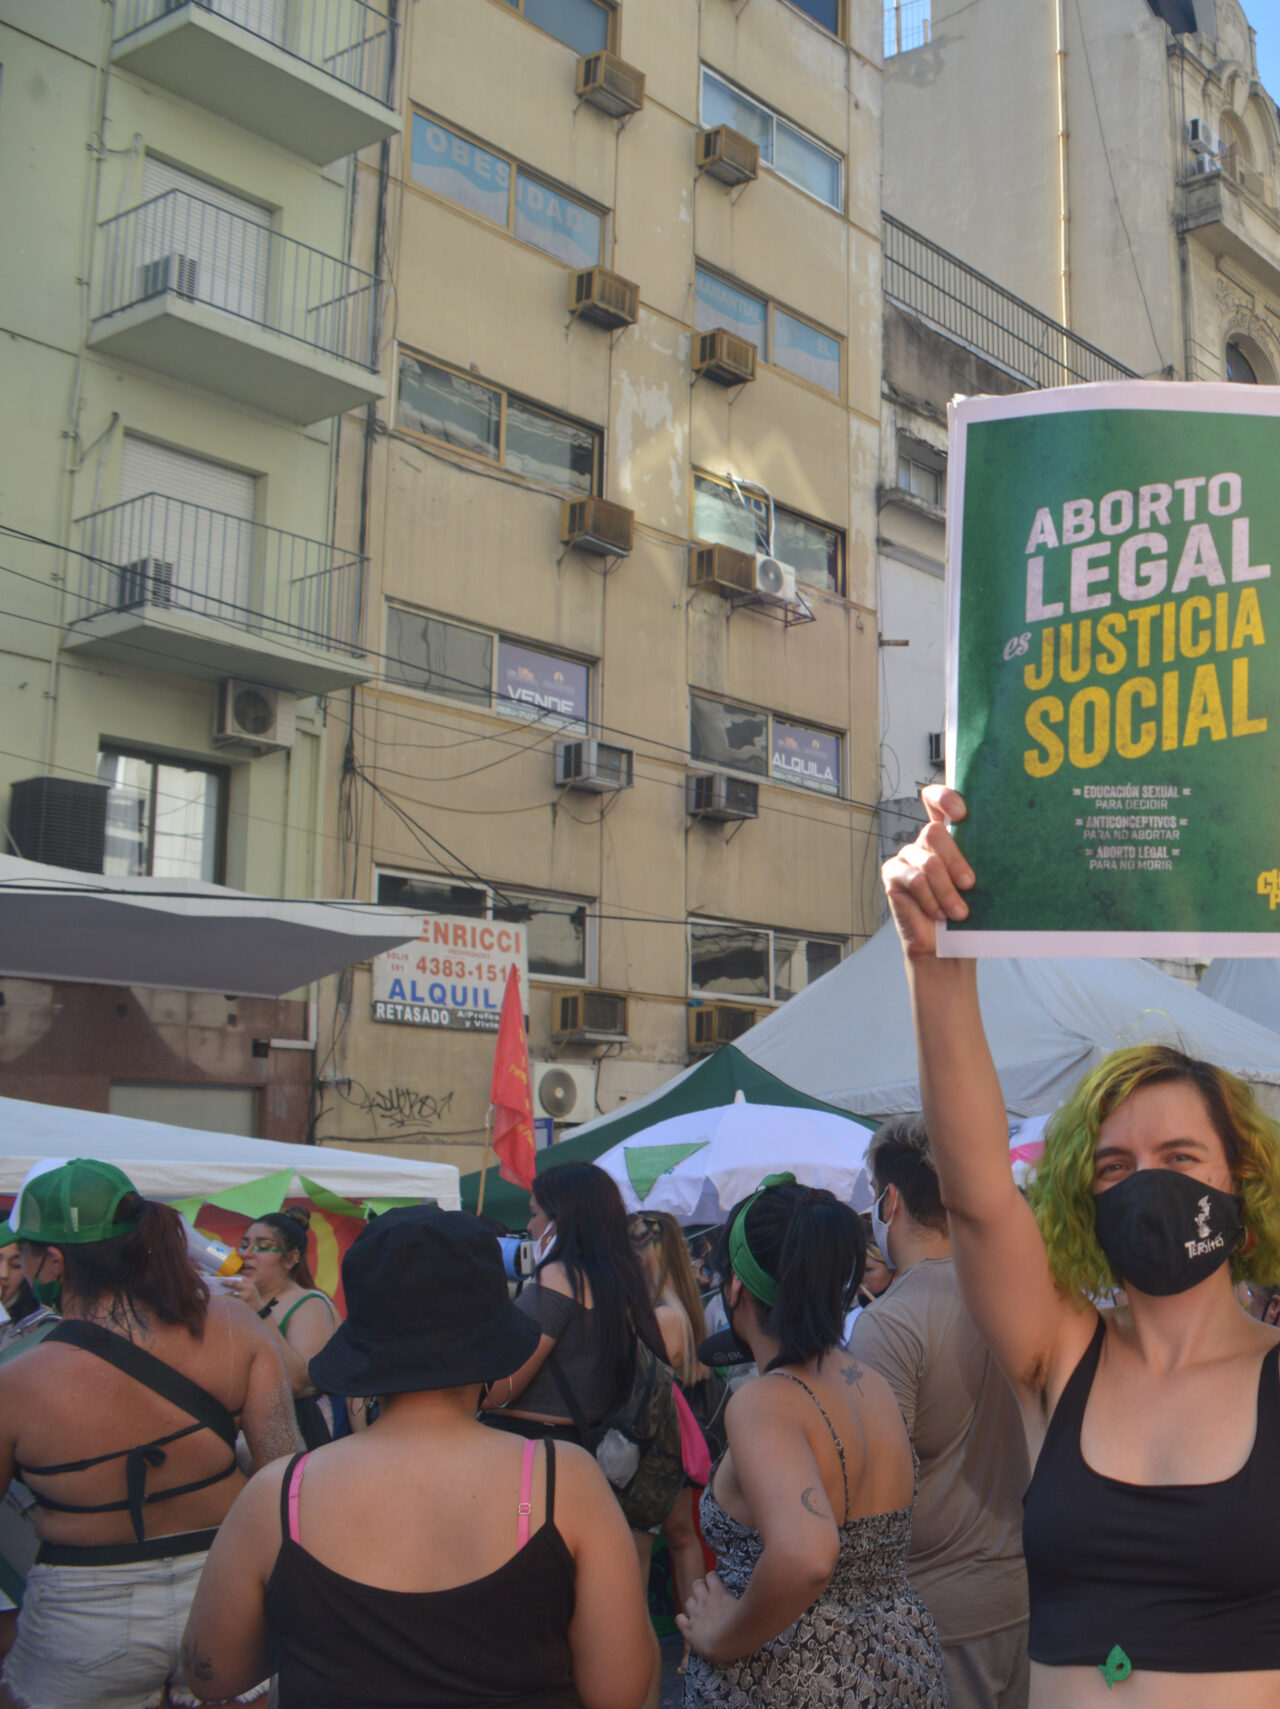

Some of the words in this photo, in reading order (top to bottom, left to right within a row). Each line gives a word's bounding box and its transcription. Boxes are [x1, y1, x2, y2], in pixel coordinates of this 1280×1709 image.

[425, 126, 583, 231] OBESIDAD
[1025, 472, 1242, 554] ABORTO
[1025, 517, 1271, 623] LEGAL
[1003, 632, 1032, 661] es
[1024, 587, 1266, 691] JUSTICIA
[507, 685, 575, 713] VENDE
[1023, 656, 1268, 778] SOCIAL
[772, 752, 833, 781] ALQUILA
[1083, 782, 1139, 799] EDUCACIÓN
[1142, 785, 1180, 798] SEXUAL
[1095, 800, 1122, 810] PARA
[1125, 799, 1168, 810] DECIDIR
[1083, 830, 1111, 840] PARA
[1114, 830, 1128, 840] NO
[1131, 829, 1180, 840] ABORTAR
[1086, 815, 1177, 828] ANTICONCEPTIVOS
[1089, 860, 1117, 870] PARA
[1120, 860, 1135, 870] NO
[1138, 859, 1173, 870] MORIR
[1096, 846, 1135, 858] ABORTO
[1138, 845, 1169, 858] LEGAL
[388, 978, 503, 1010] ALQUIL
[376, 1002, 449, 1025] RETASADO
